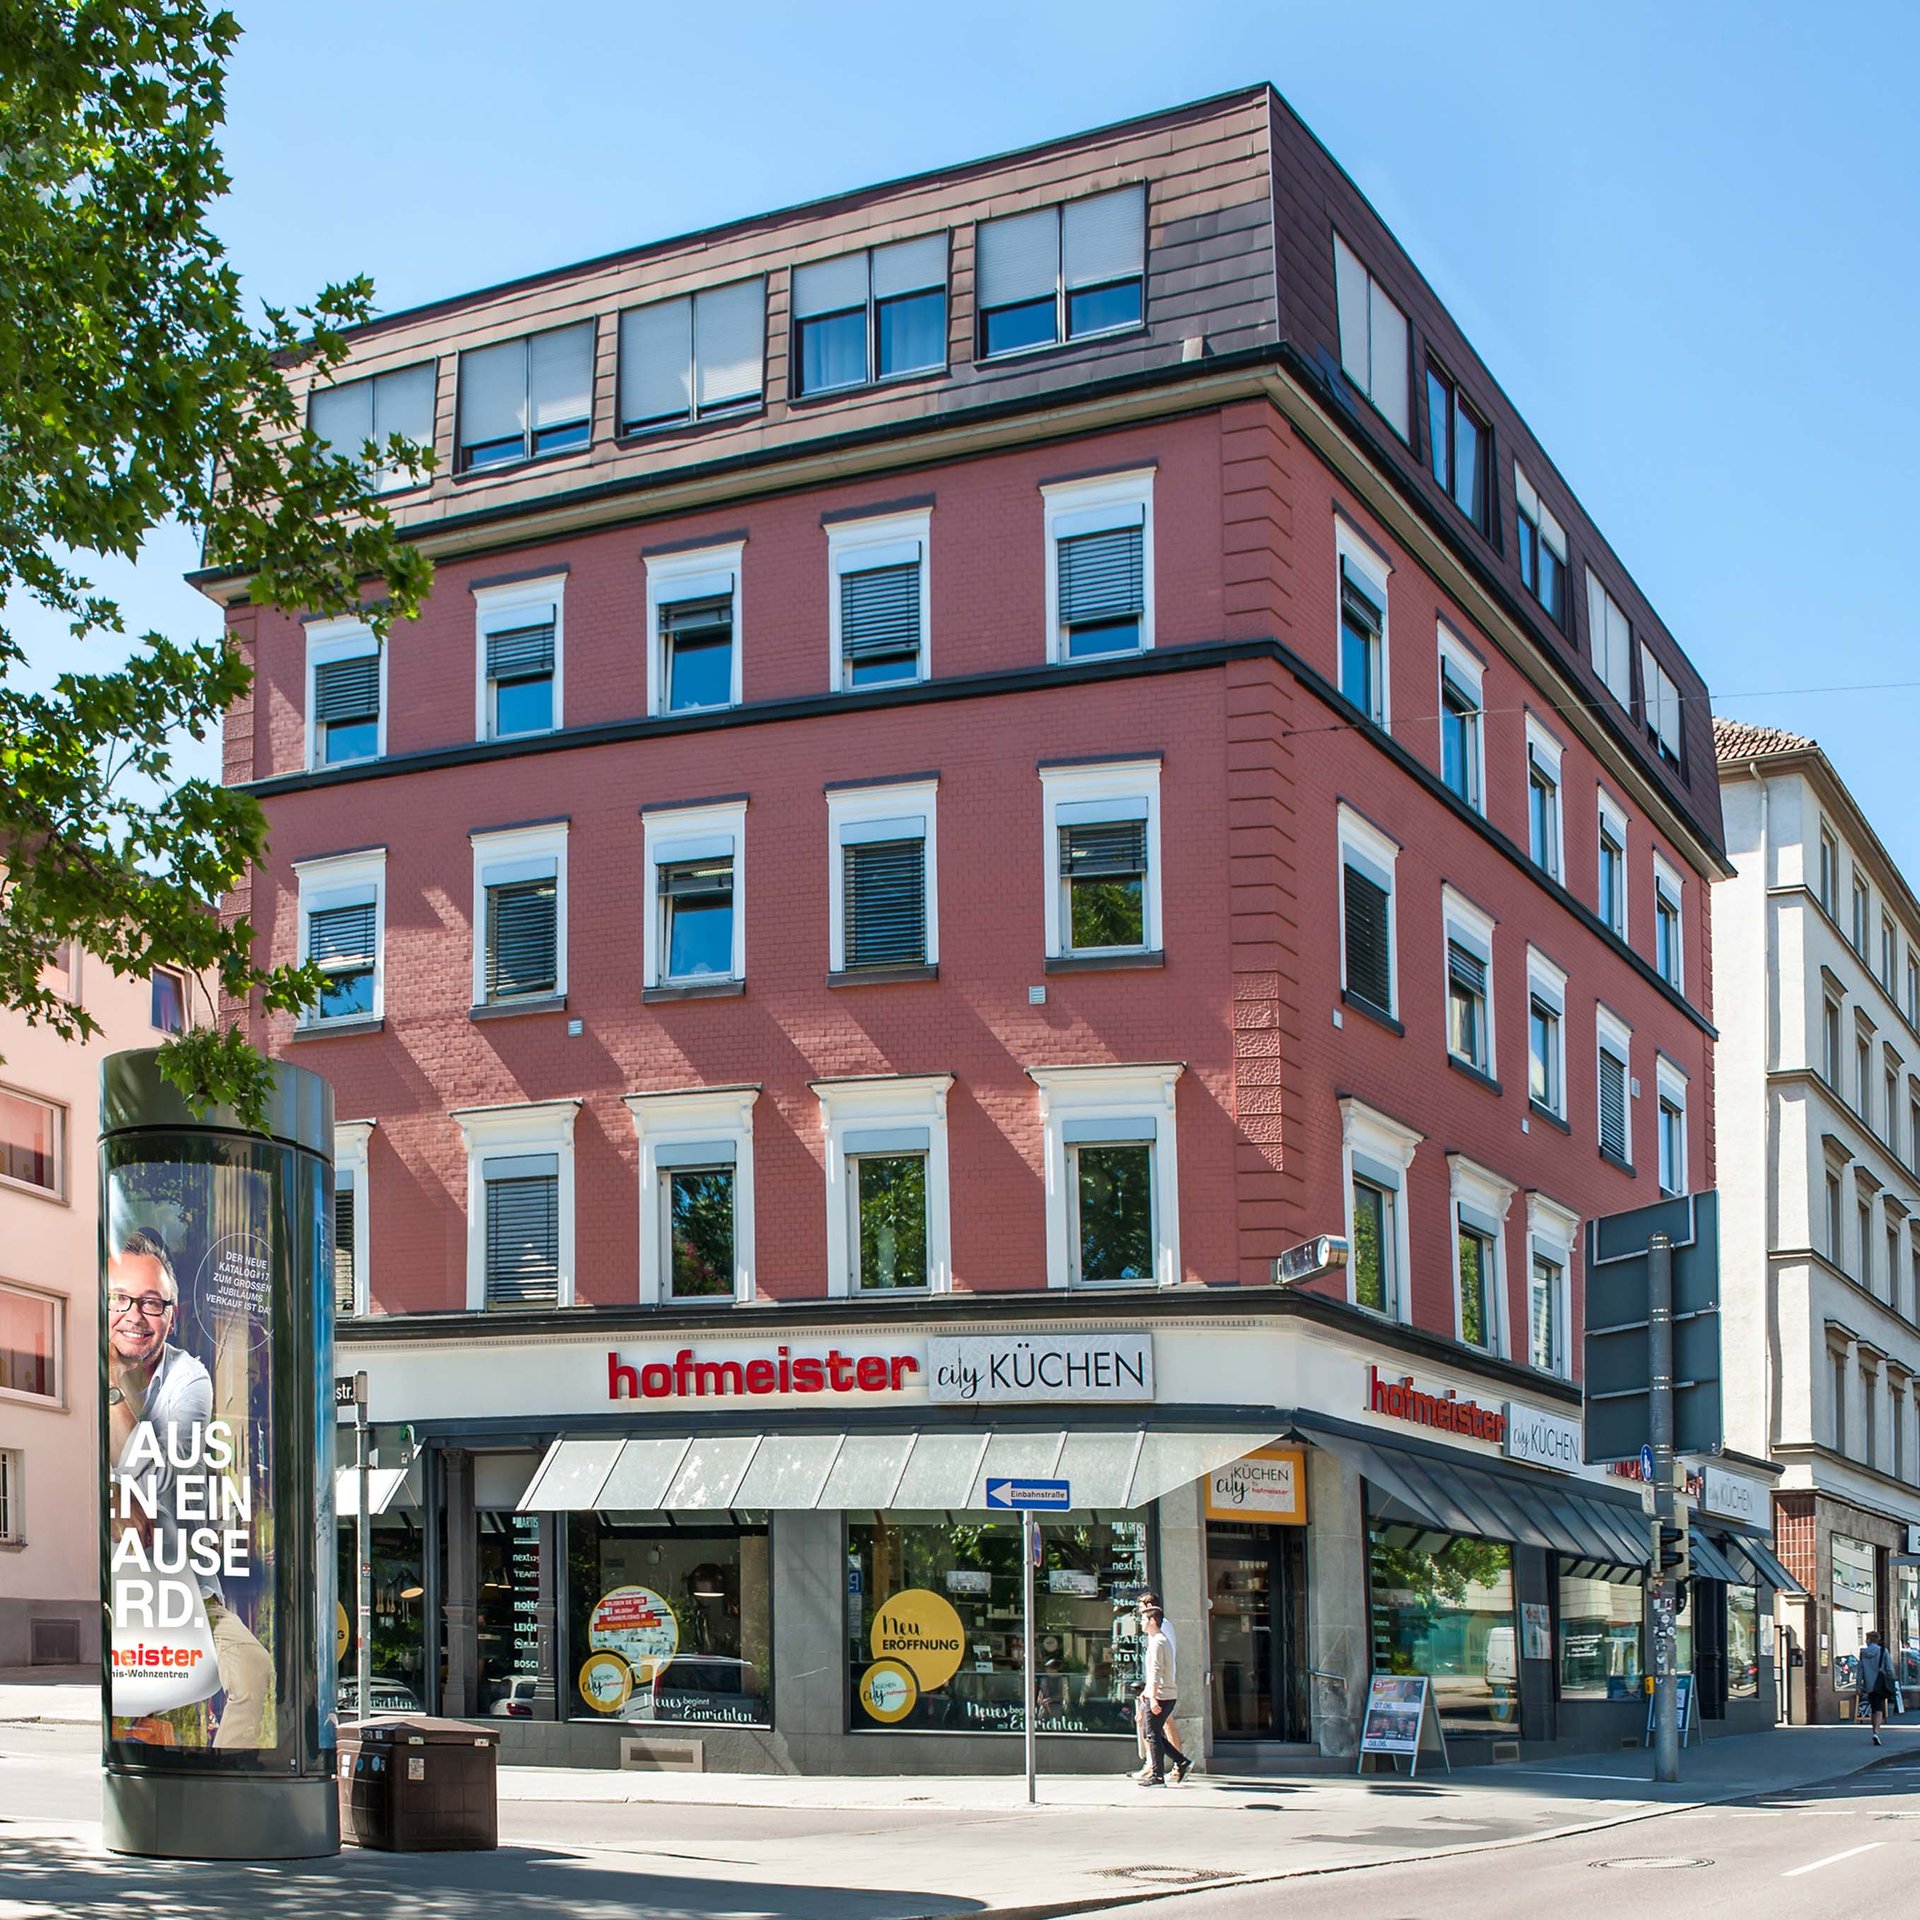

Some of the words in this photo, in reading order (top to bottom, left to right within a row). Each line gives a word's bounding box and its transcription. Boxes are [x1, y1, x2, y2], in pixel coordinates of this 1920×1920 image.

[225, 1251, 244, 1264] DER
[244, 1256, 268, 1270] NEUE
[212, 1272, 232, 1285] ZUM
[233, 1278, 272, 1293] GROSSEN
[205, 1293, 243, 1309] VERKAUF
[243, 1302, 257, 1312] IST
[607, 1345, 921, 1400] hofmeister
[937, 1343, 986, 1399] city
[990, 1342, 1144, 1389] KÜCHEN
[1370, 1365, 1508, 1443] hofmeister
[1531, 1417, 1580, 1464] KÜCHEN
[124, 1420, 233, 1469] AUS
[1234, 1464, 1289, 1481] KÜCHEN
[110, 1474, 158, 1519] N
[176, 1474, 252, 1522] EIN
[1010, 1490, 1066, 1499] Einbahnstraße
[1216, 1473, 1249, 1504] city
[1251, 1486, 1289, 1495] hofmeister
[882, 1614, 921, 1636] Neu
[882, 1636, 960, 1651] ERÖFFNUNG
[966, 1701, 1008, 1719] Neues
[1009, 1714, 1089, 1732] Eirichten.
